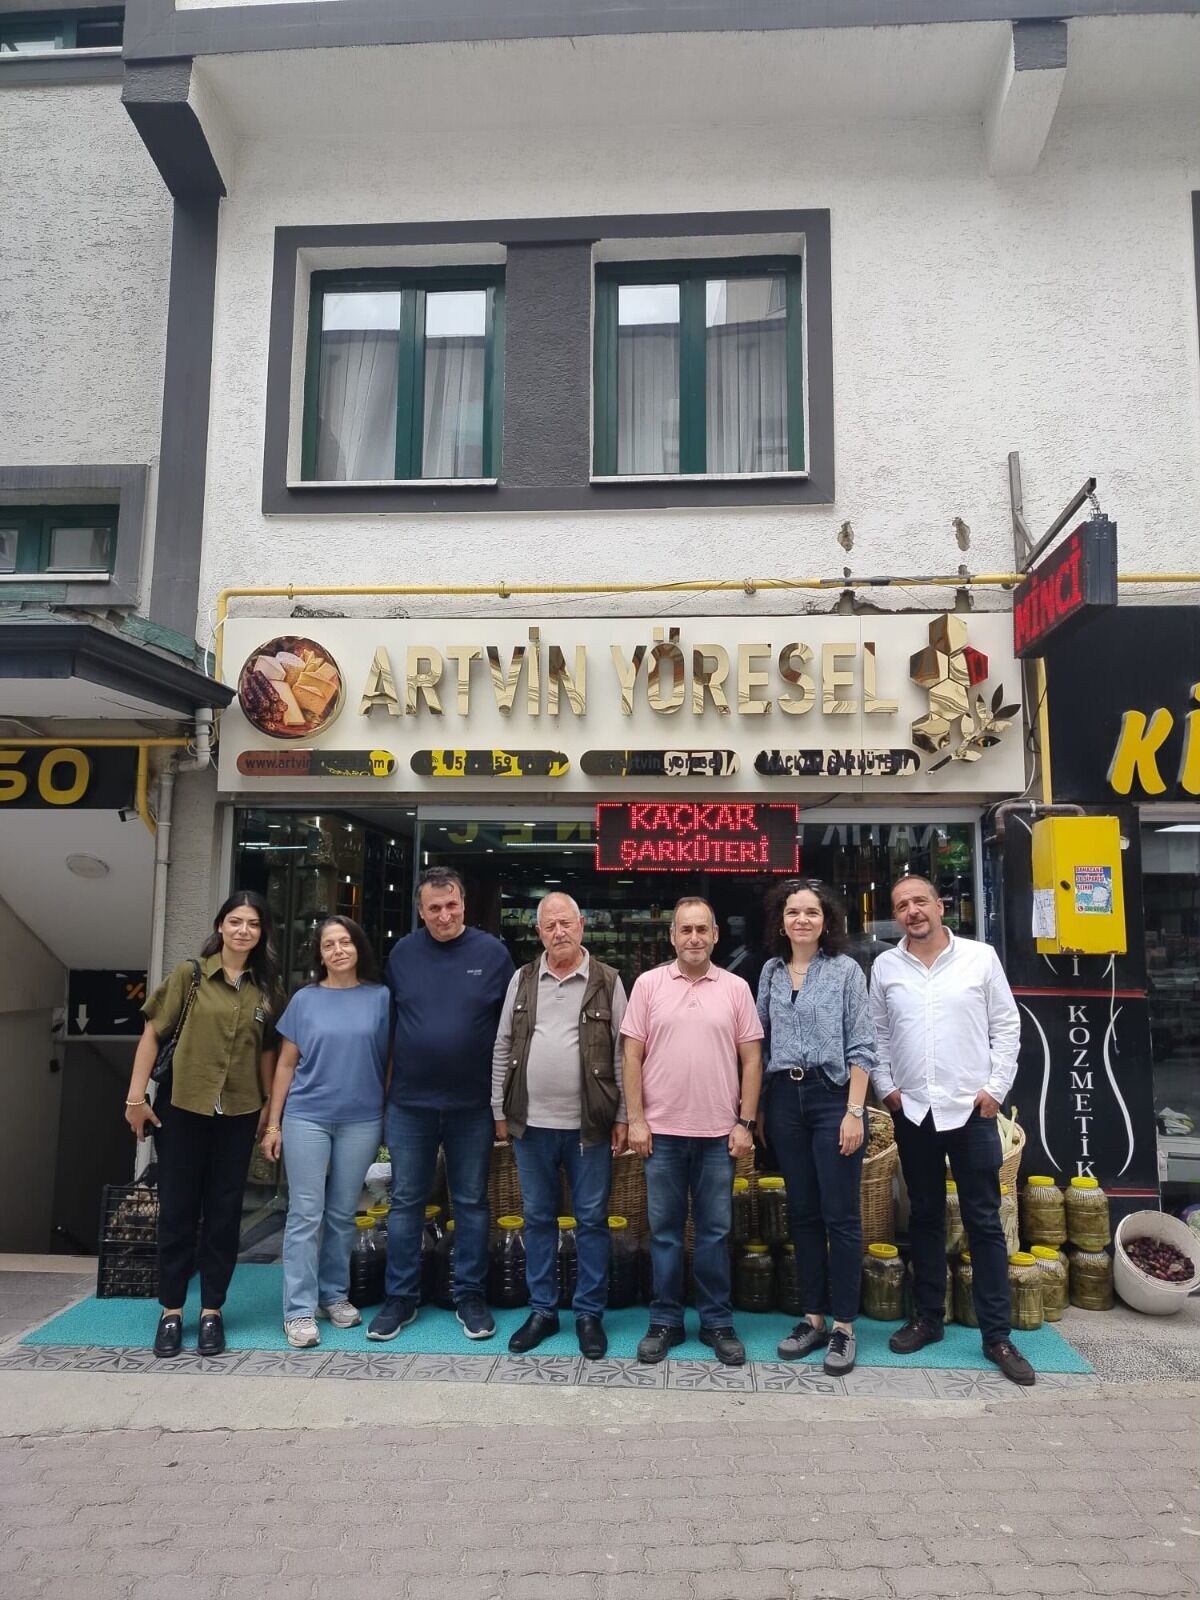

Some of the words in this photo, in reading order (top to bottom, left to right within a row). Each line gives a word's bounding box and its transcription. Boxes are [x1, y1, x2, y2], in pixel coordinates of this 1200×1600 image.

[1015, 535, 1082, 652] MİNCİ
[357, 626, 588, 716] ARTVİN
[609, 626, 899, 716] YÖRESEL
[621, 835, 769, 867] ŞARKÜTERİ
[631, 805, 758, 836] KAÇKAR
[1067, 1005, 1097, 1179] KOZMETİK
